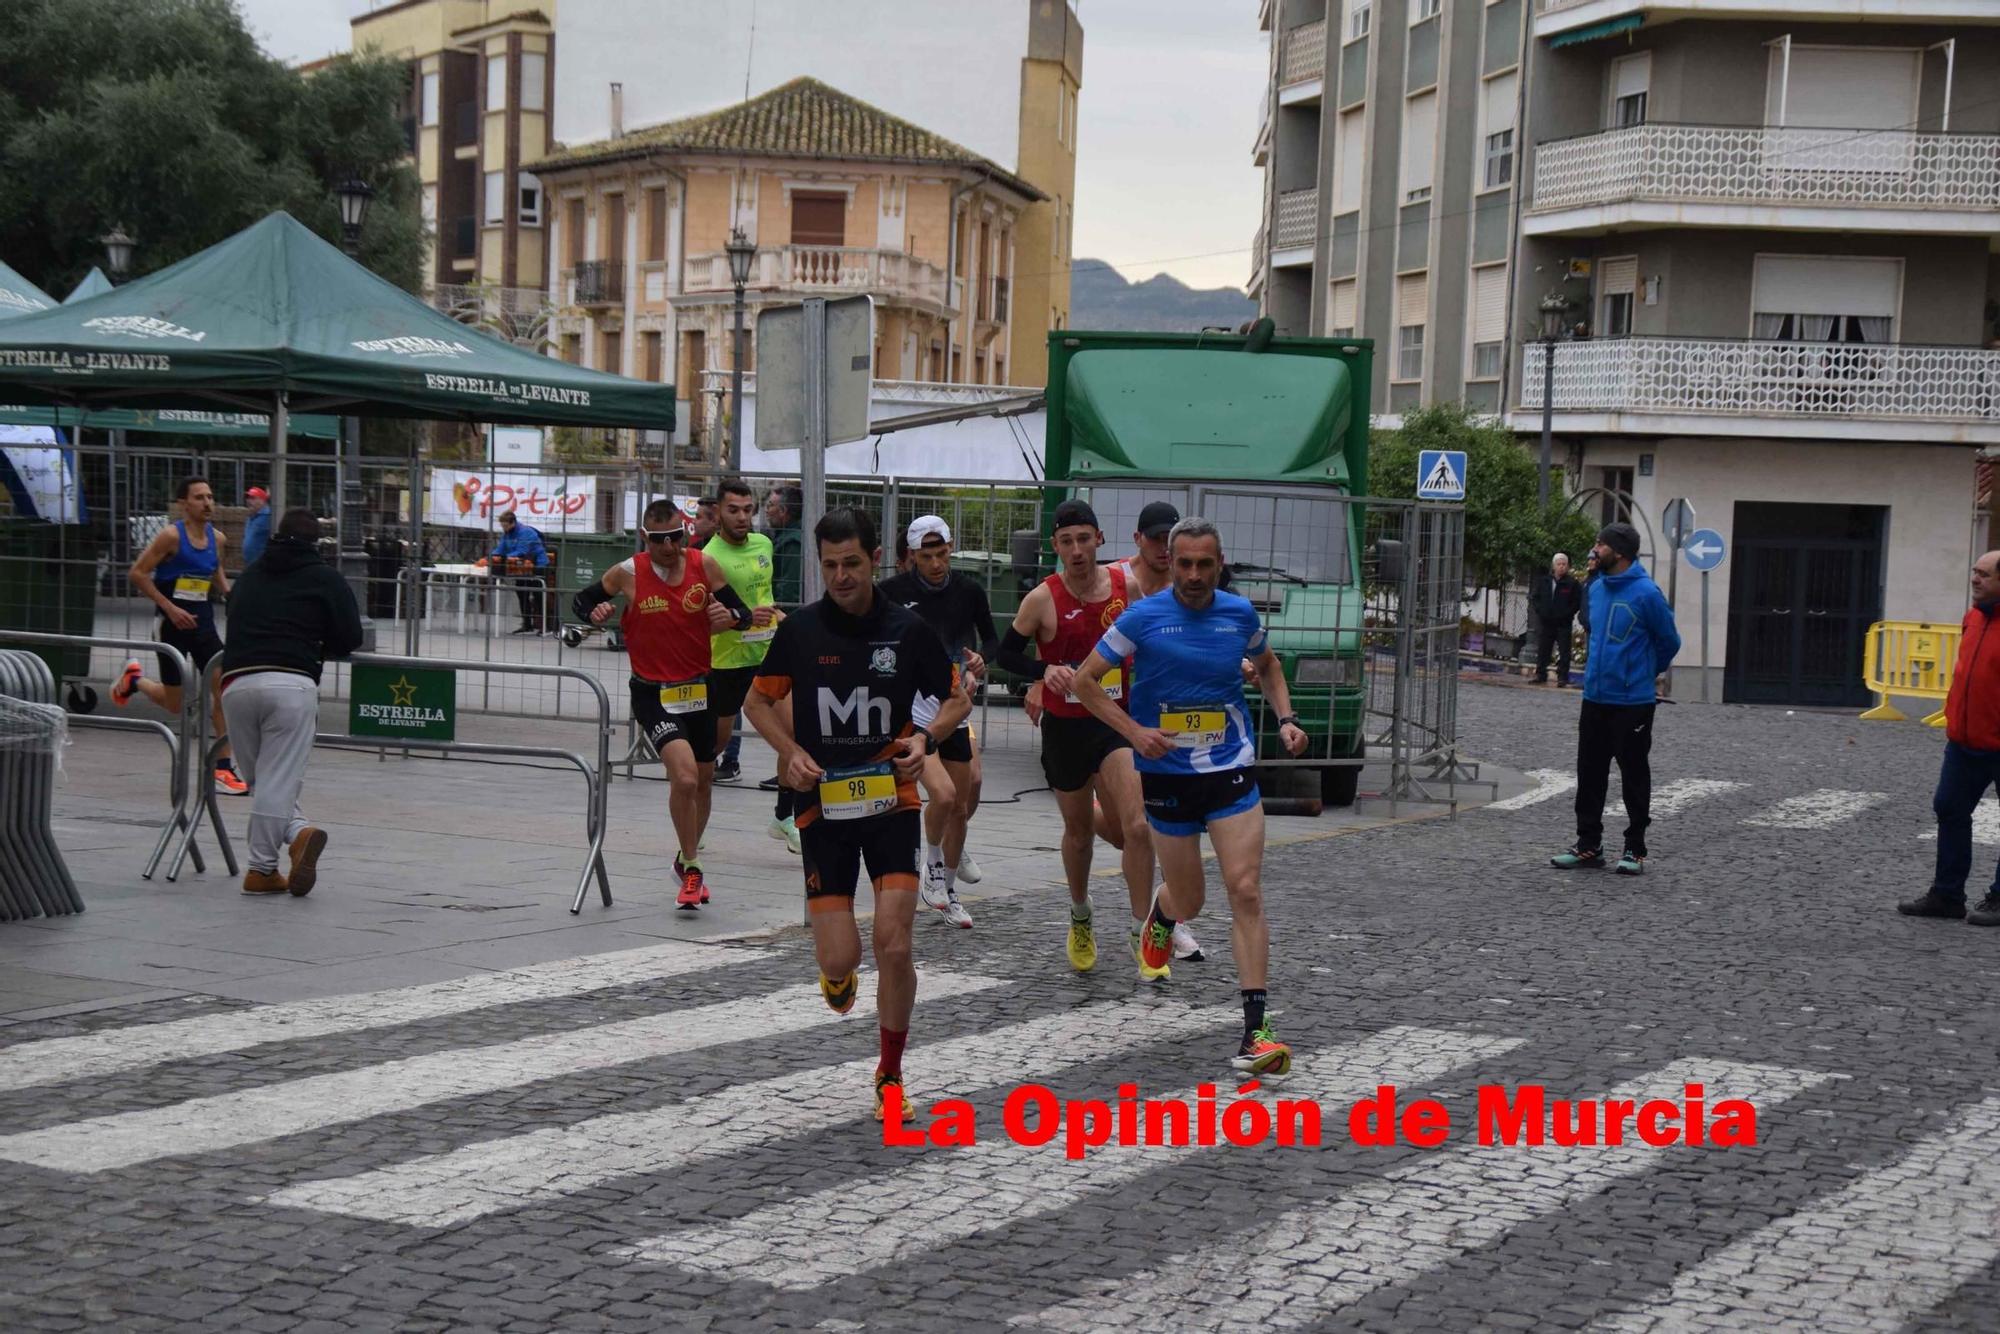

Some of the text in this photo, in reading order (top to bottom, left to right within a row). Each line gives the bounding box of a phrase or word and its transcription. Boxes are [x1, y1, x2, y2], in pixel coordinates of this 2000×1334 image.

[87, 352, 171, 371] LEVANTE
[425, 373, 508, 396] ESTRELLA
[520, 383, 591, 406] LEVANTE
[158, 409, 223, 423] ESTRELLA
[677, 686, 693, 699] 191
[358, 703, 446, 721] ESTRELLA
[818, 686, 892, 736] Mh
[390, 719, 426, 727] LEVANTE
[1185, 714, 1201, 729] 93
[848, 780, 866, 797] 98
